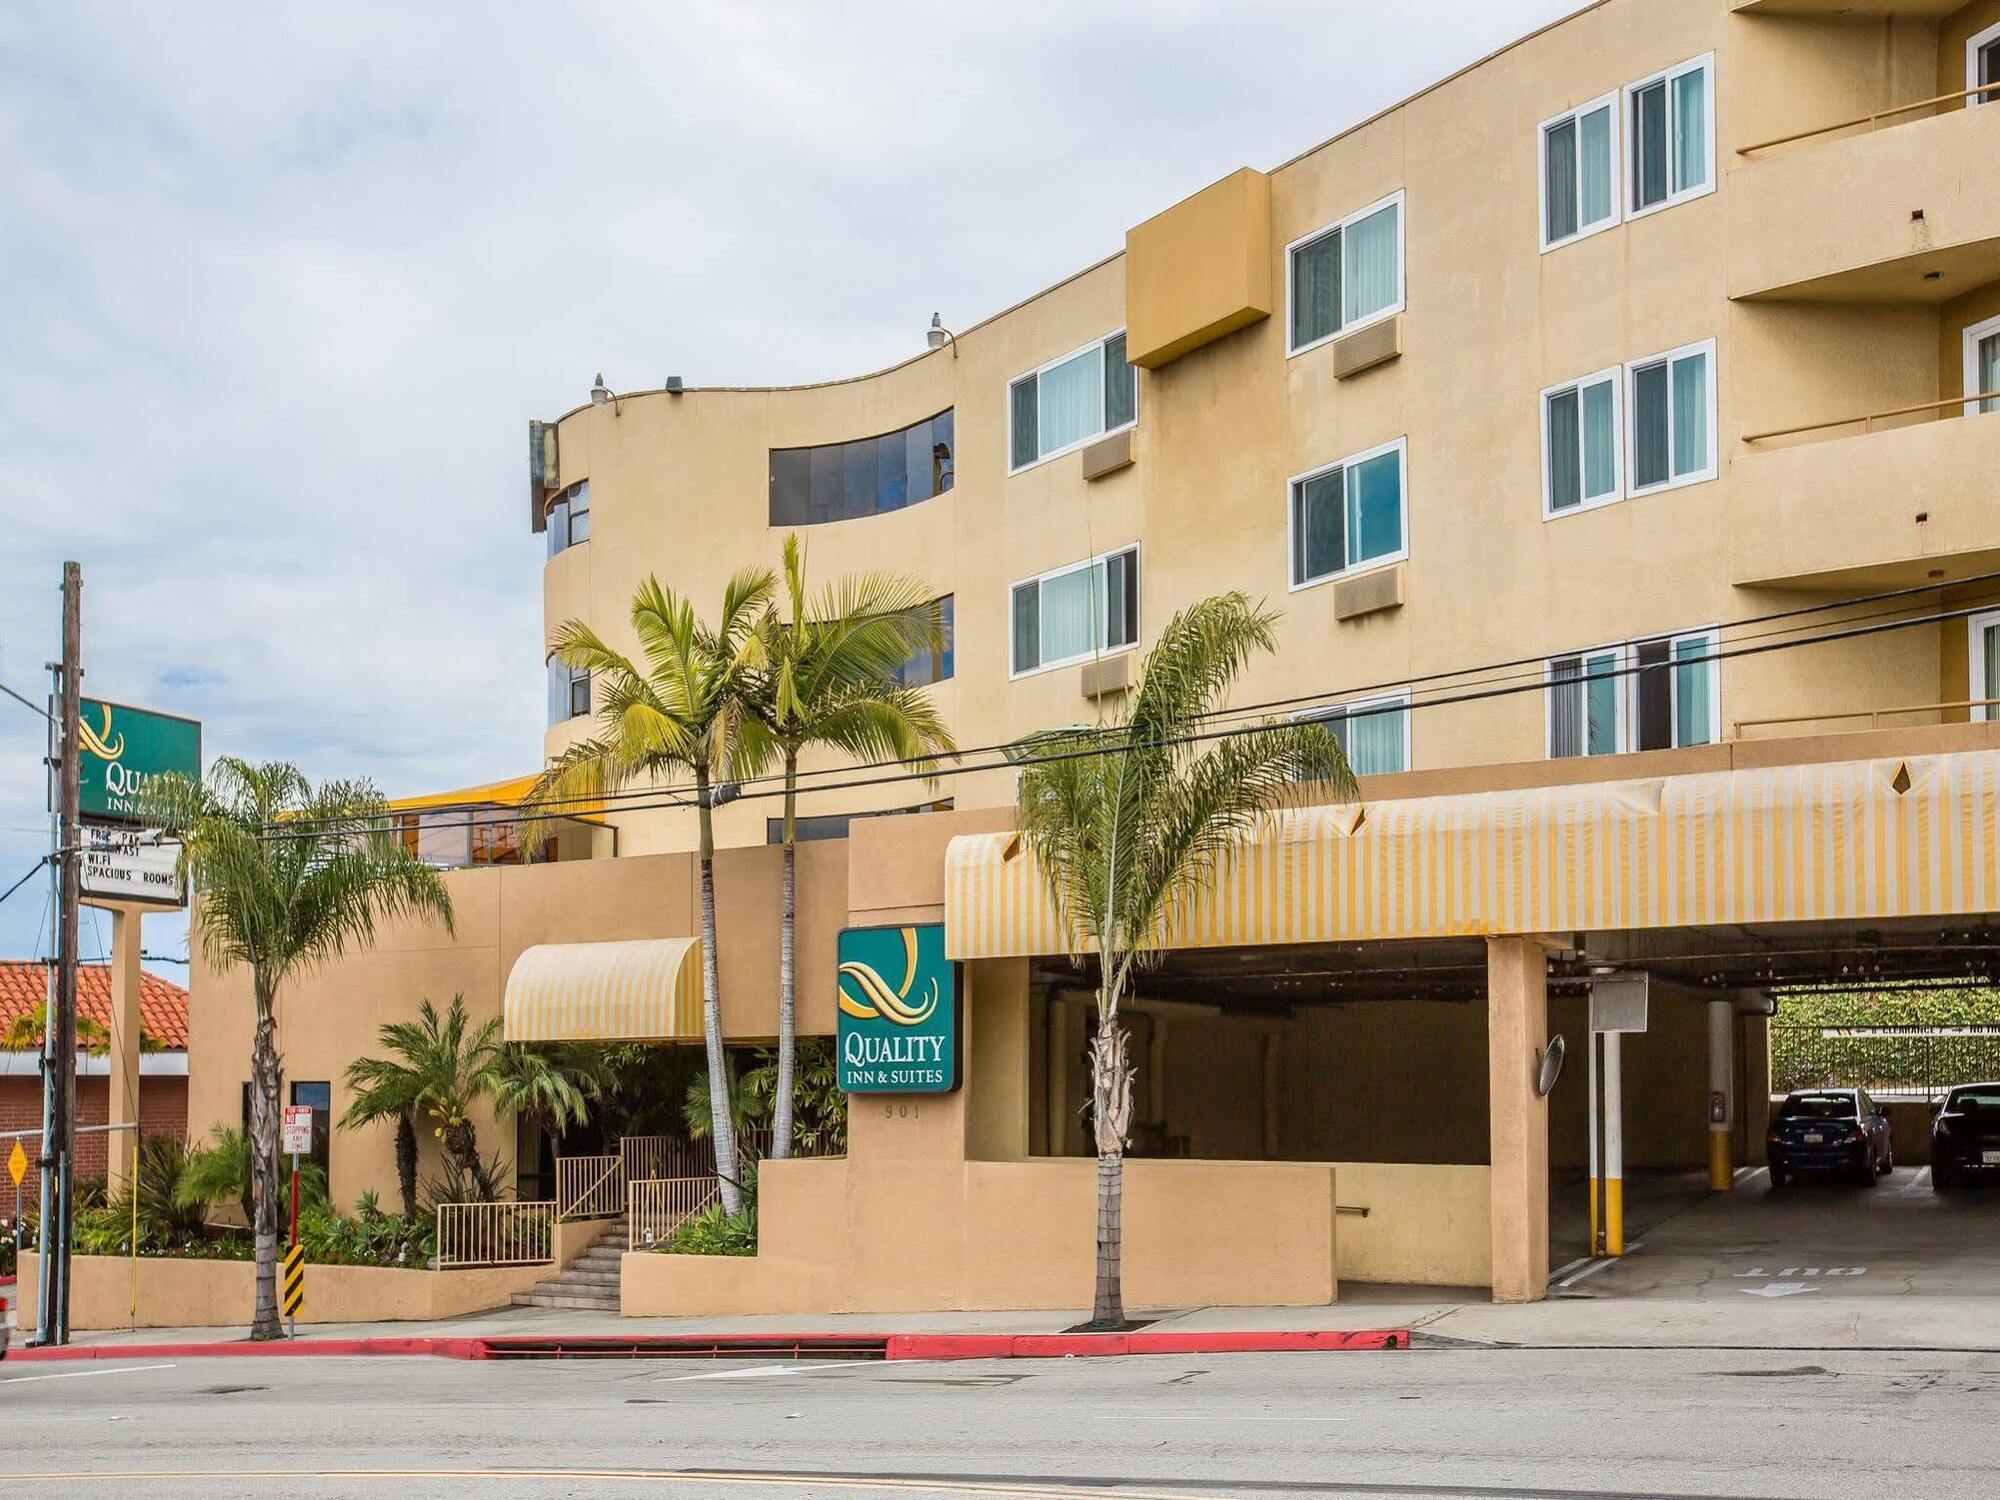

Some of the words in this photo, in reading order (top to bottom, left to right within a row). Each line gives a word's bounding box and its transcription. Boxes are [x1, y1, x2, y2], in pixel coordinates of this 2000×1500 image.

[107, 797, 134, 813] INN
[87, 866, 132, 881] SPACIOUS
[143, 872, 174, 886] ROOMS
[845, 1031, 946, 1067] QUALITY
[847, 1071, 874, 1084] INN
[877, 1070, 888, 1083] &
[891, 1069, 943, 1083] SUITES
[885, 1104, 919, 1119] 901
